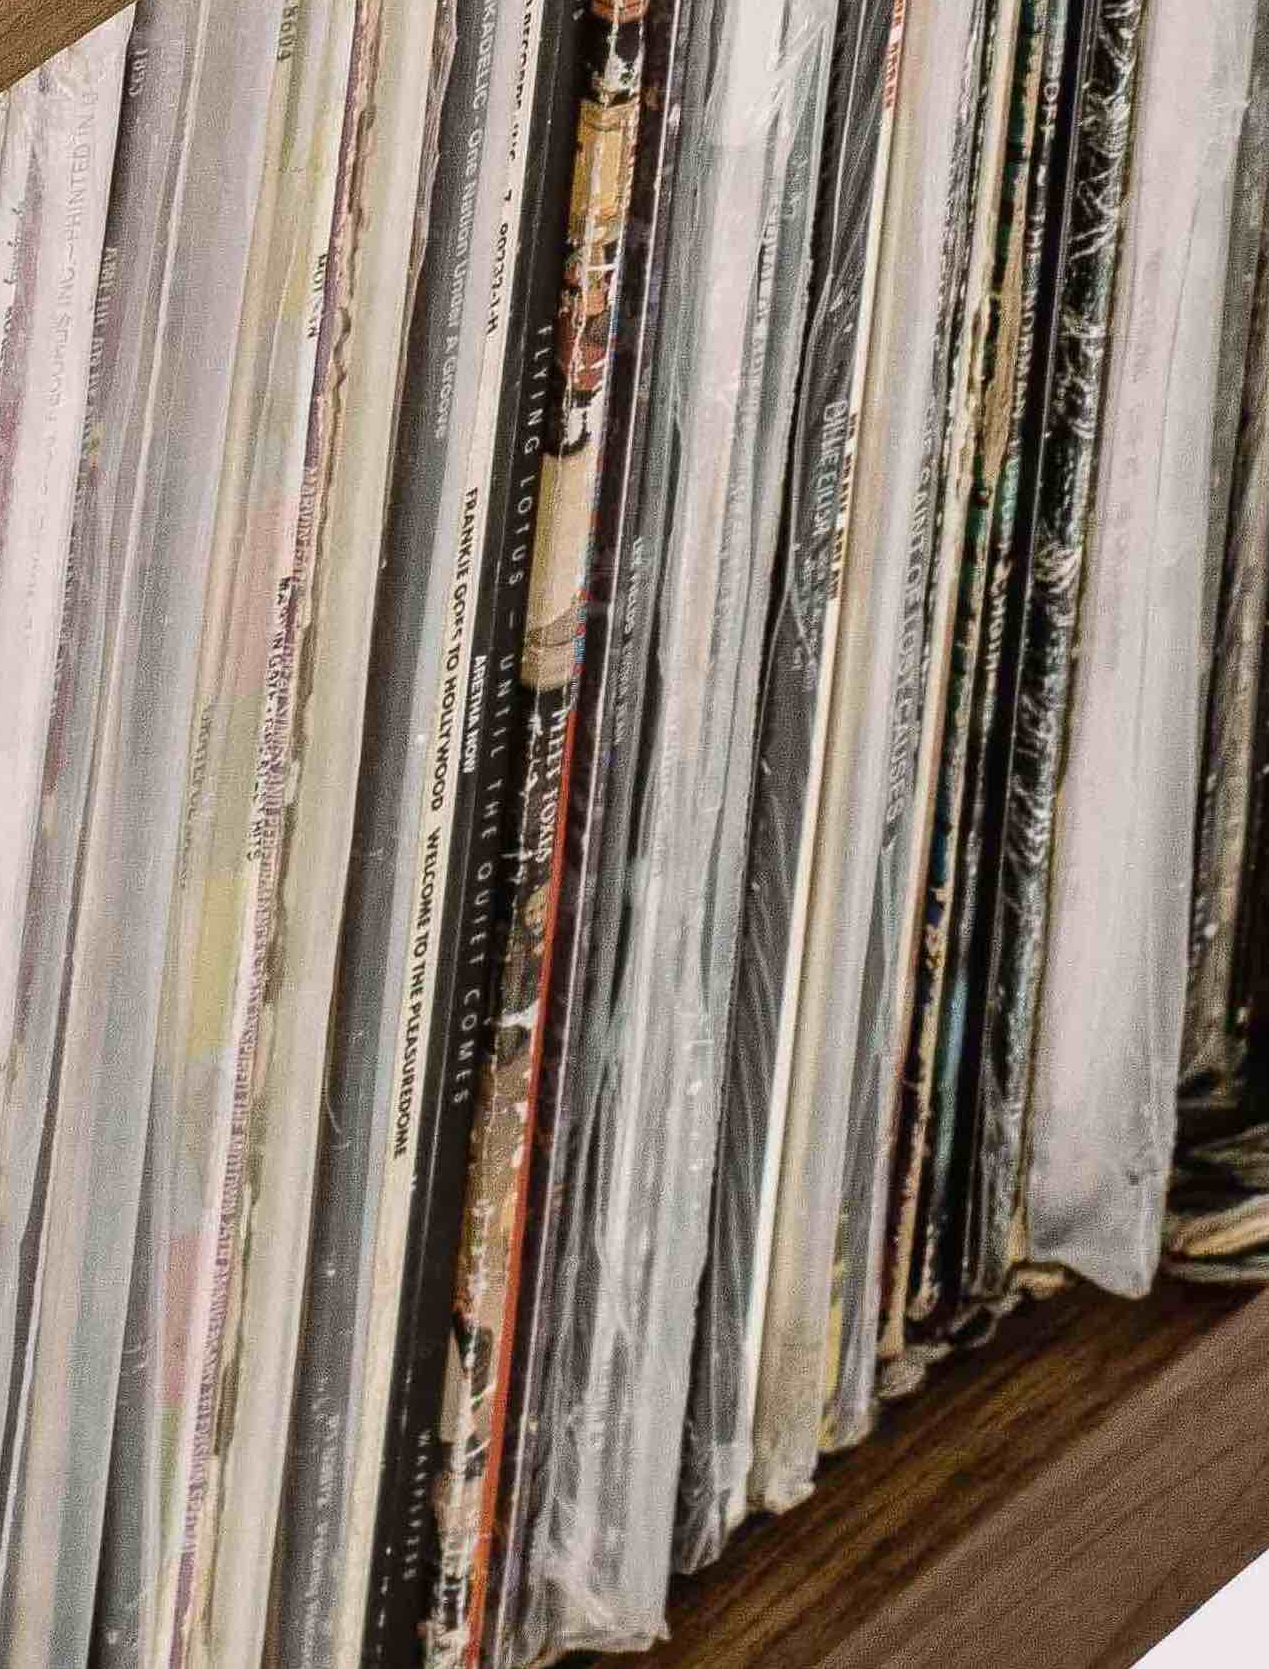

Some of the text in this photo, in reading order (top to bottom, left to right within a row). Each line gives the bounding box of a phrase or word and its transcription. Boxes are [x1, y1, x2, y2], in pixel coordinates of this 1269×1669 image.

[465, 127, 483, 178] One
[455, 181, 477, 260] Nation
[448, 262, 469, 329] Under
[449, 323, 554, 1105] FLYING LOTUS UNTIL THE QUIET COMES
[462, 654, 488, 774] ARETHA NOW
[392, 485, 479, 1161] FRANKIE GOES TO HOLLYWOOD WELCOME TO THE PLEASUREDOME
